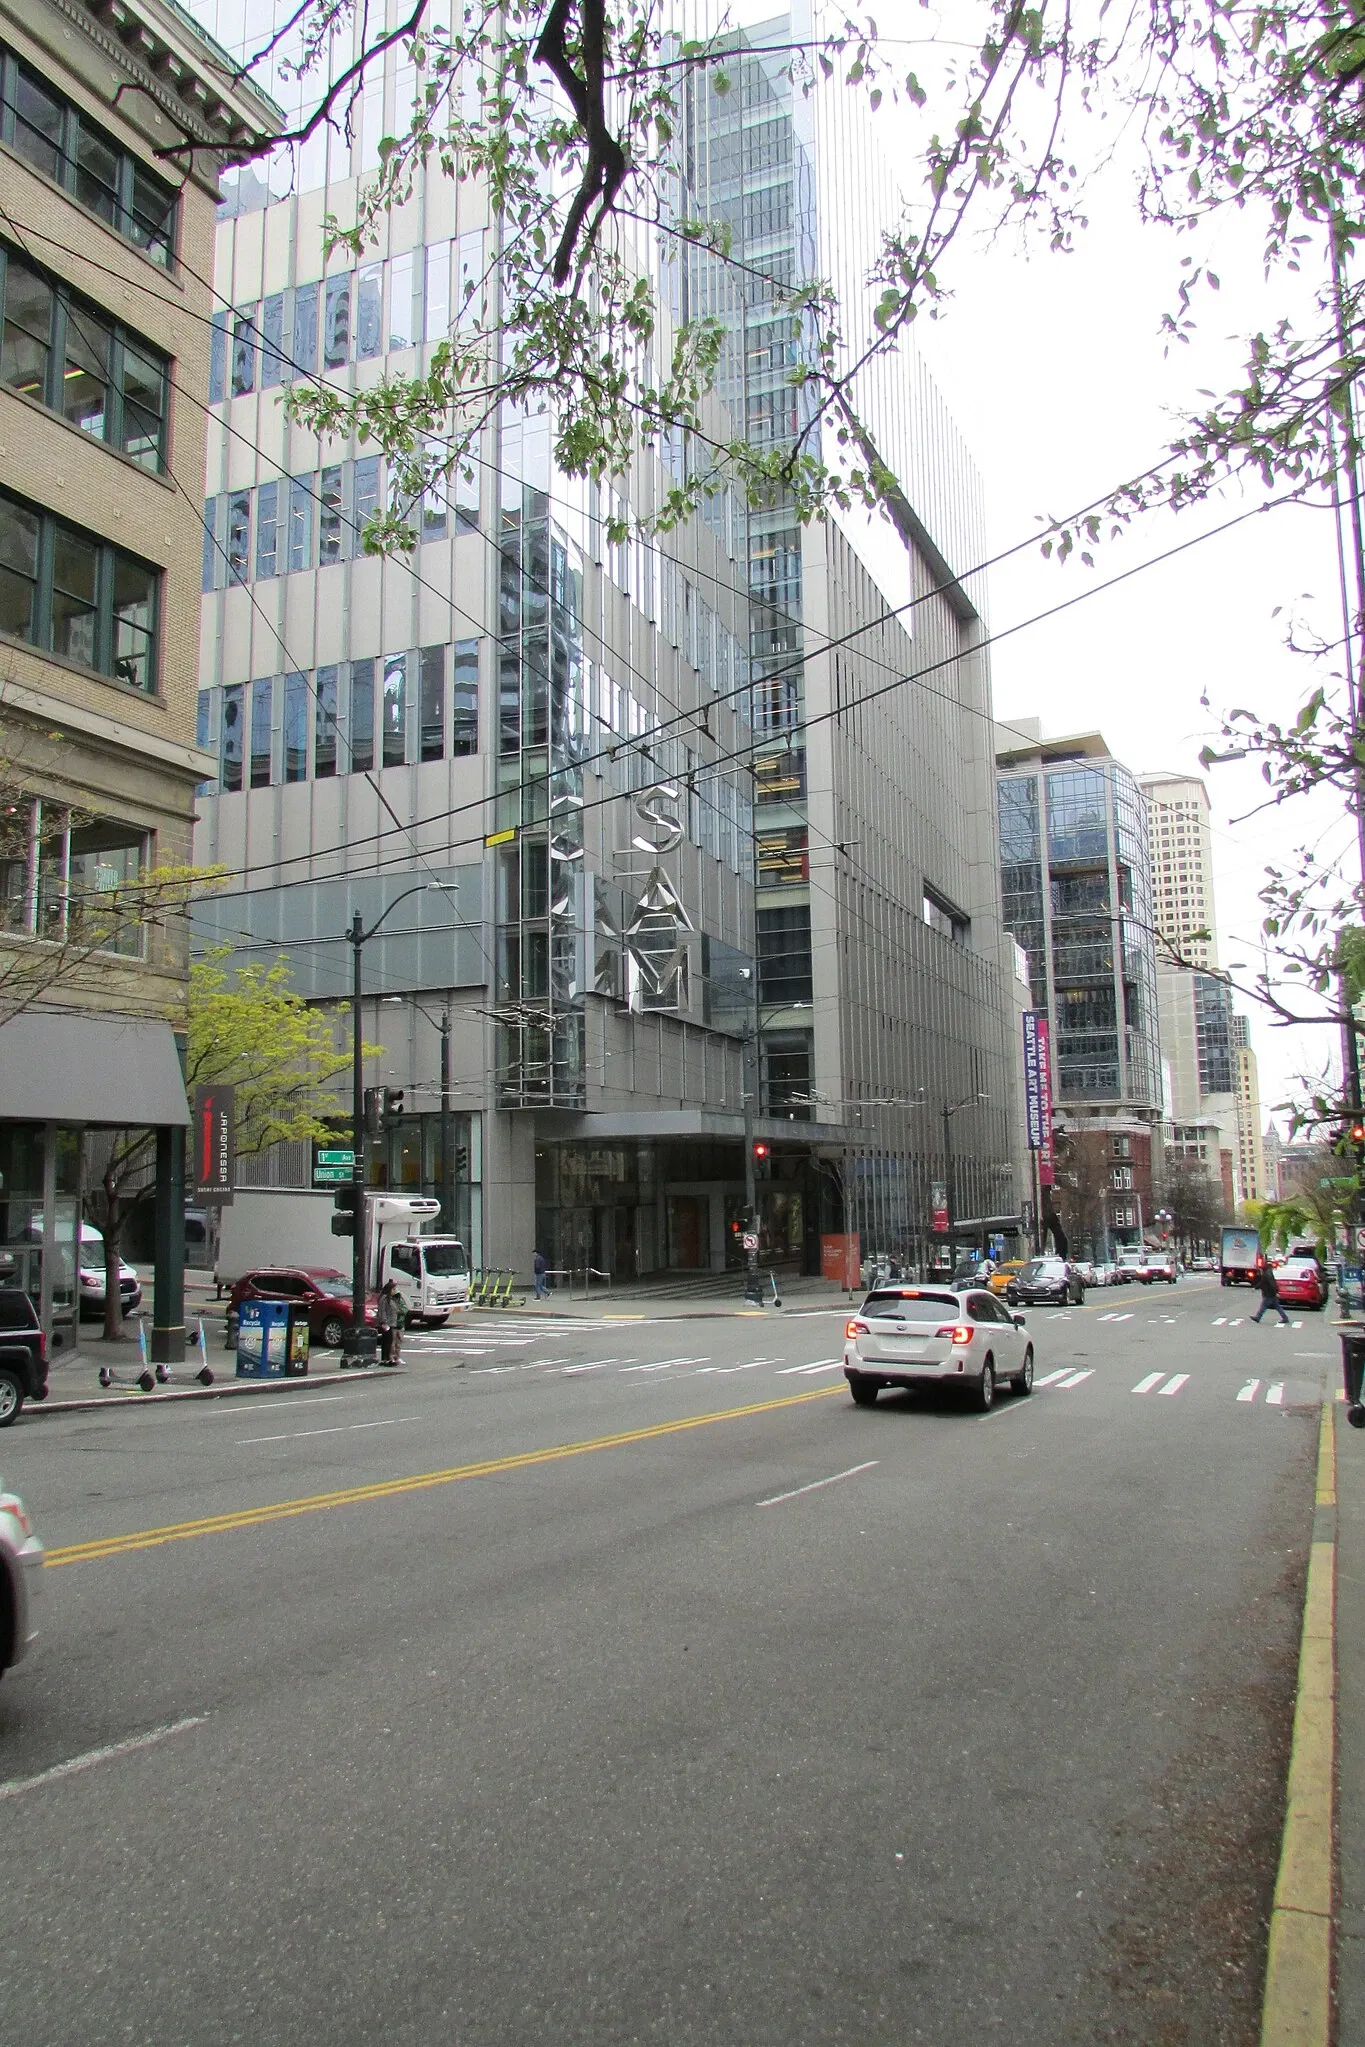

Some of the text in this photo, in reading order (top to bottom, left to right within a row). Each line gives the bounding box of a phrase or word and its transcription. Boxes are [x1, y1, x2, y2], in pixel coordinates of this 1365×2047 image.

[626, 786, 695, 1015] SAM
[1025, 1015, 1040, 1146] SEATTLE ART MUSEUM
[1038, 1036, 1051, 1168] TAKE ME TO THE ART
[220, 1111, 228, 1182] JAPONESSA
[316, 1170, 334, 1178] Union
